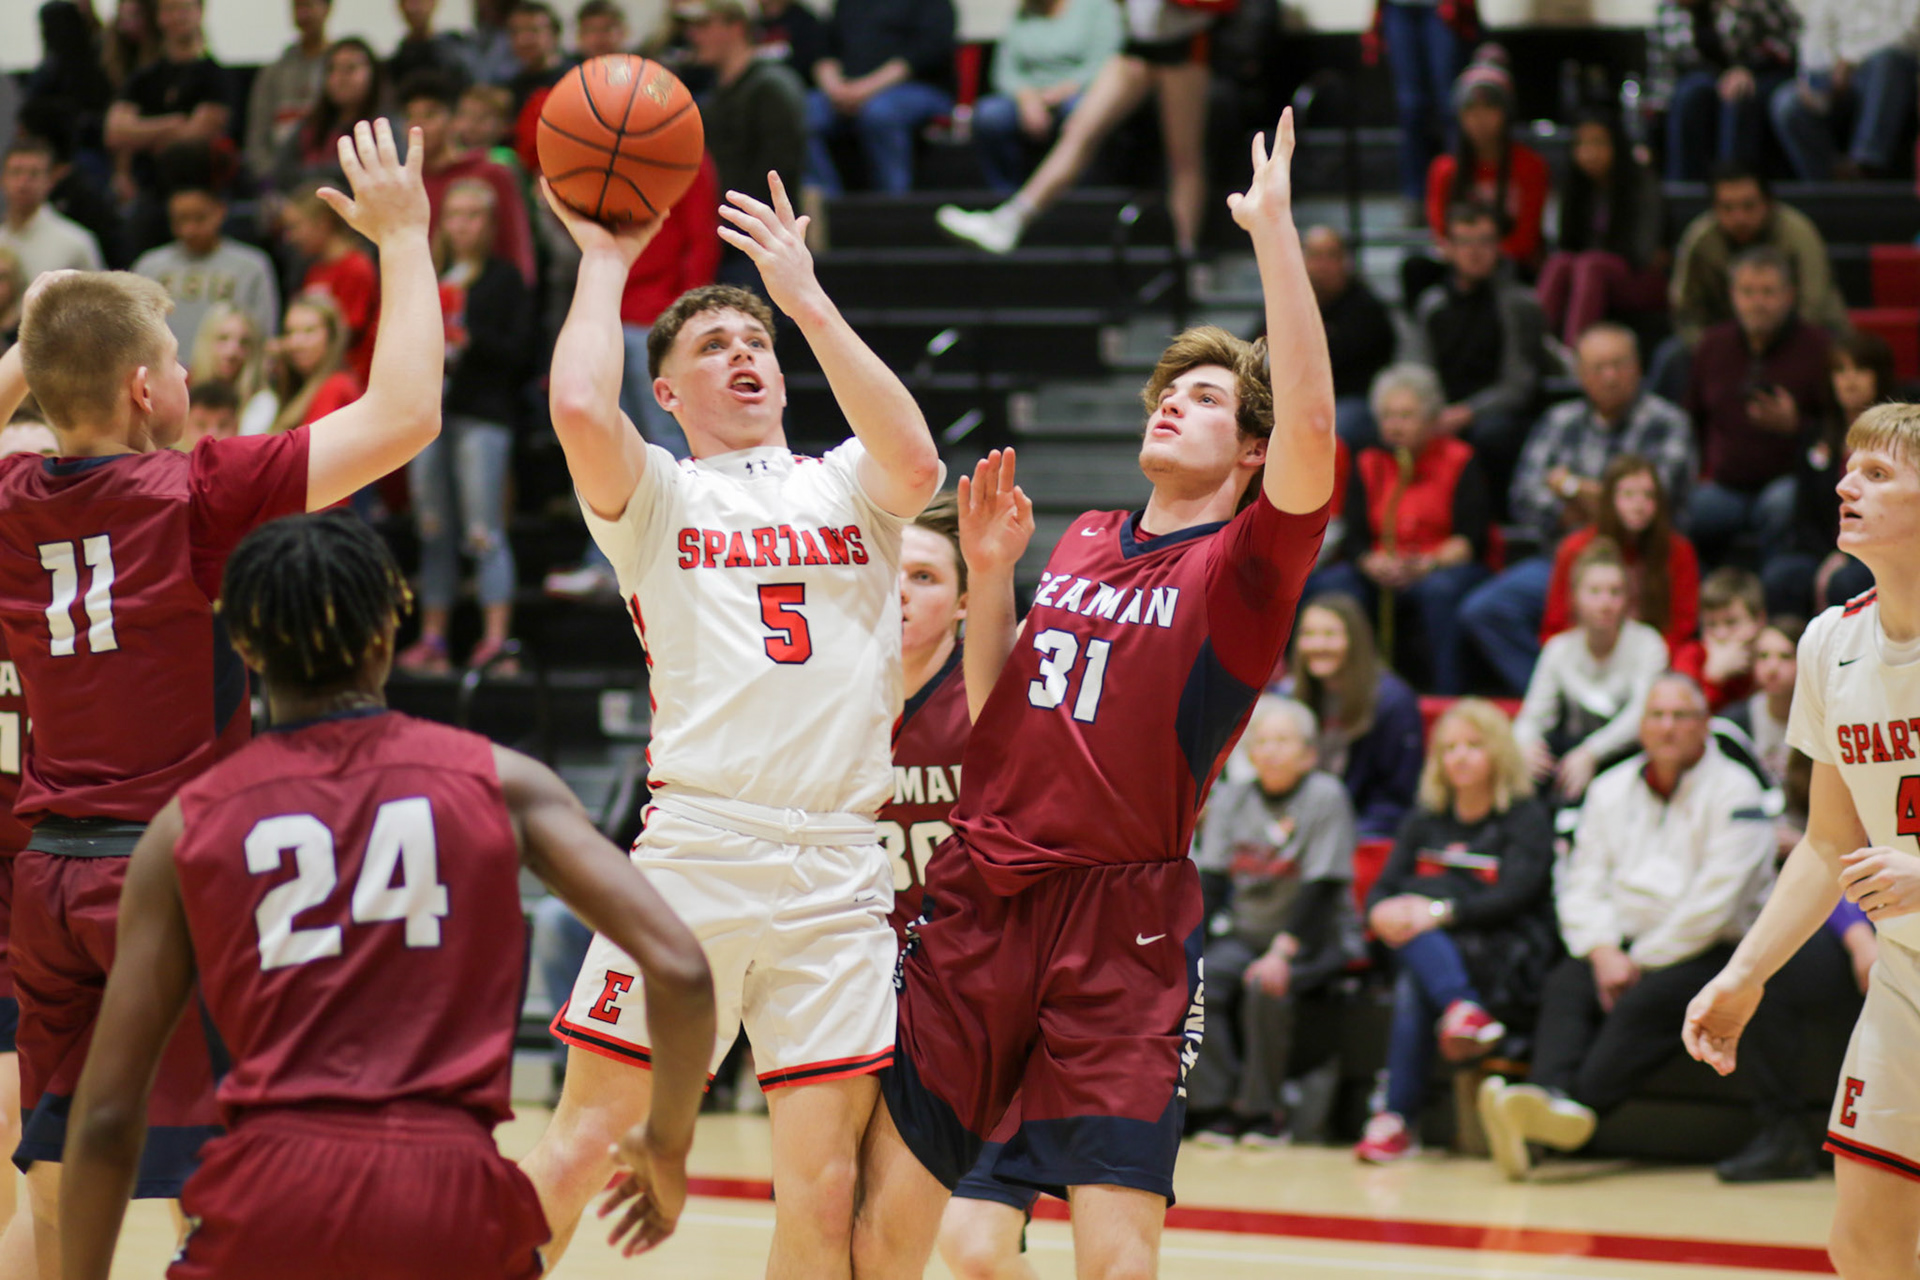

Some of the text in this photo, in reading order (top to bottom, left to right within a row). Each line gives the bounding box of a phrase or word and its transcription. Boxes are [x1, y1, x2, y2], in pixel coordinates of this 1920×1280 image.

[678, 524, 869, 569] SPARTANS
[36, 533, 119, 657] 11
[757, 582, 813, 665] 5
[1028, 627, 1113, 724] 31
[244, 797, 449, 971] 24
[588, 970, 634, 1025] E
[1839, 1076, 1865, 1128] E
